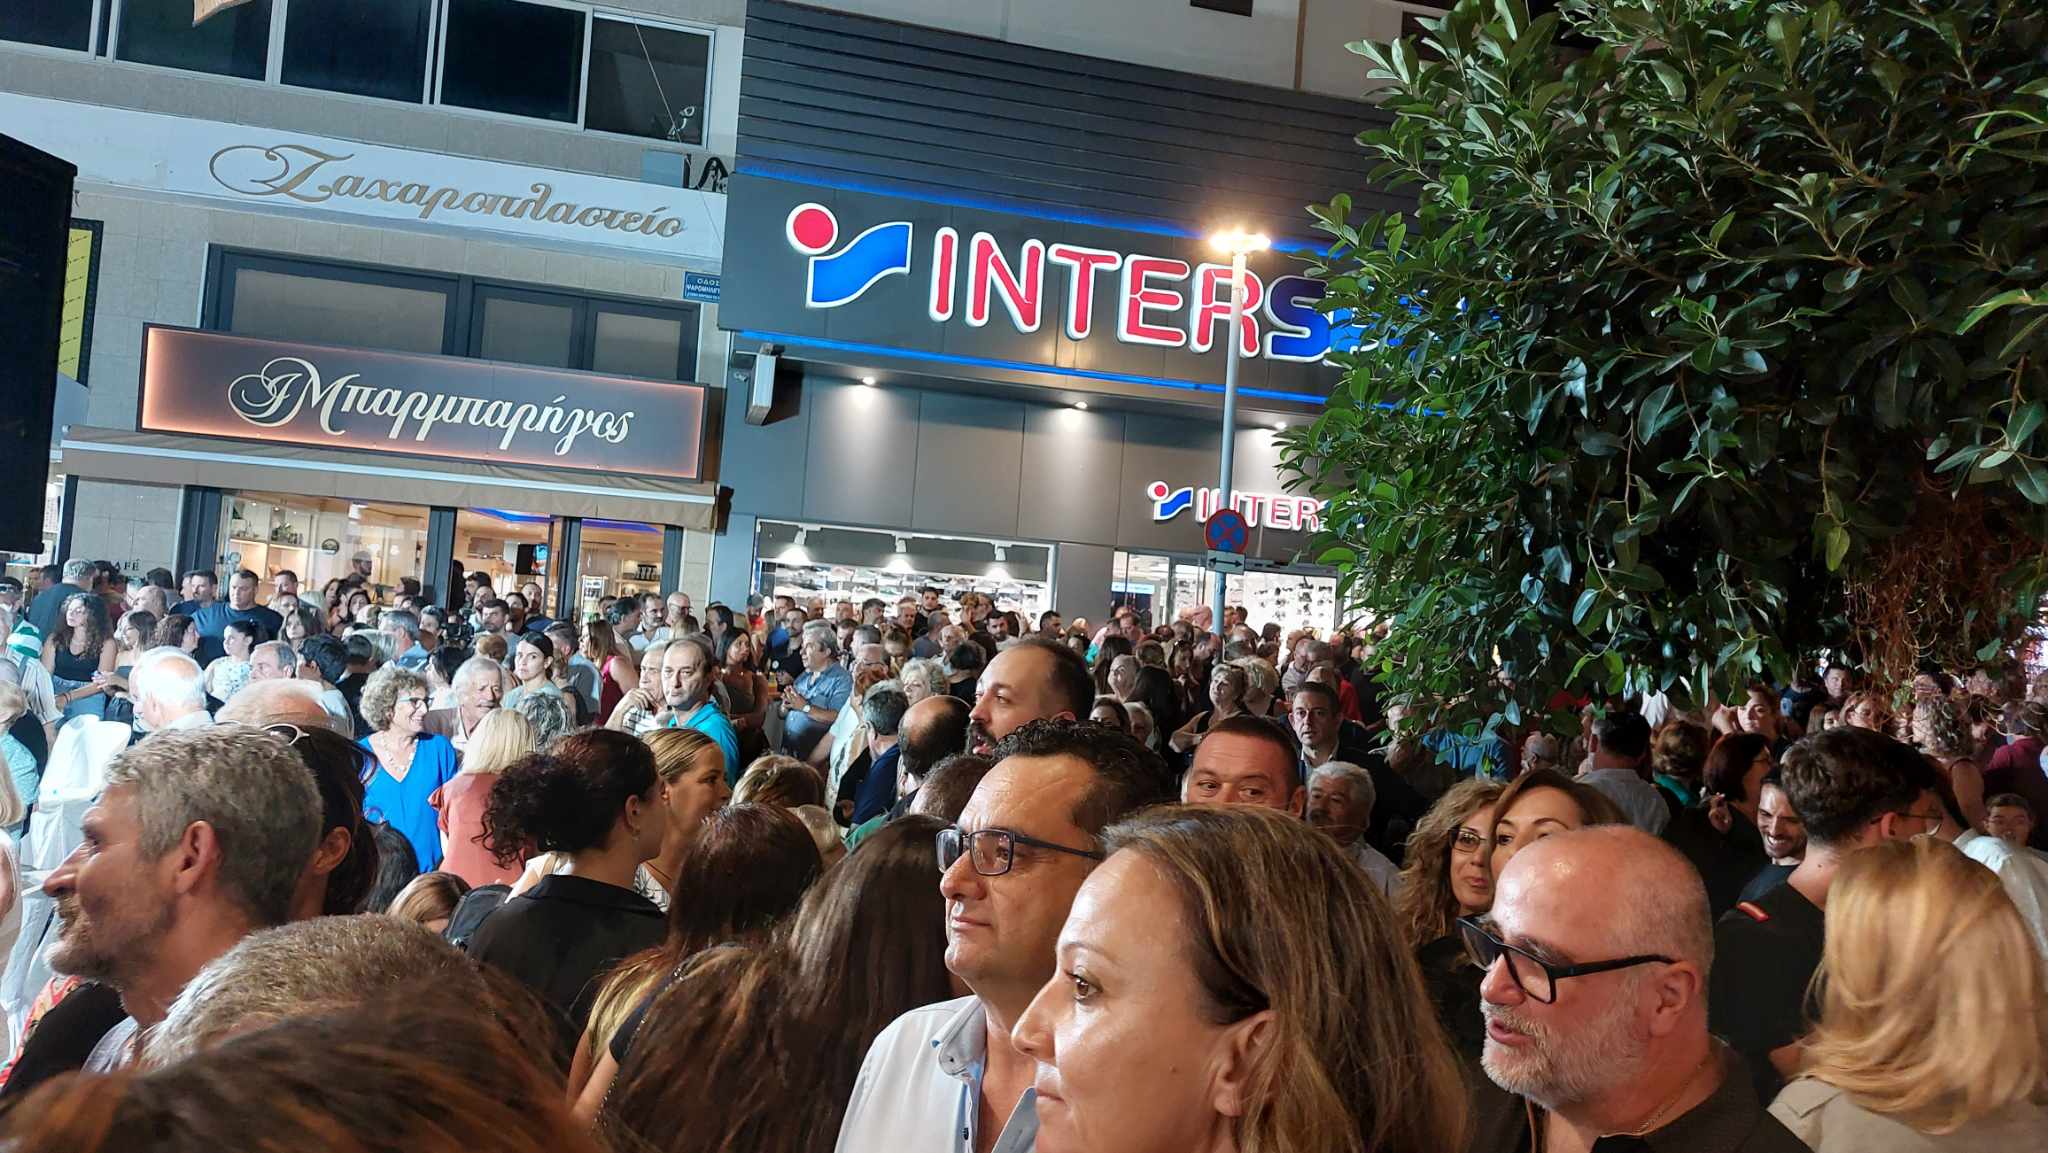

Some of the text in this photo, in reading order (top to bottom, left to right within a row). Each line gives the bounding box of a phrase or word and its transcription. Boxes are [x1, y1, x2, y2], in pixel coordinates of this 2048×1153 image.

[209, 144, 687, 238] Ζαχαροπλαστείο
[928, 226, 1376, 364] INTERS
[1195, 487, 1330, 532] ITER
